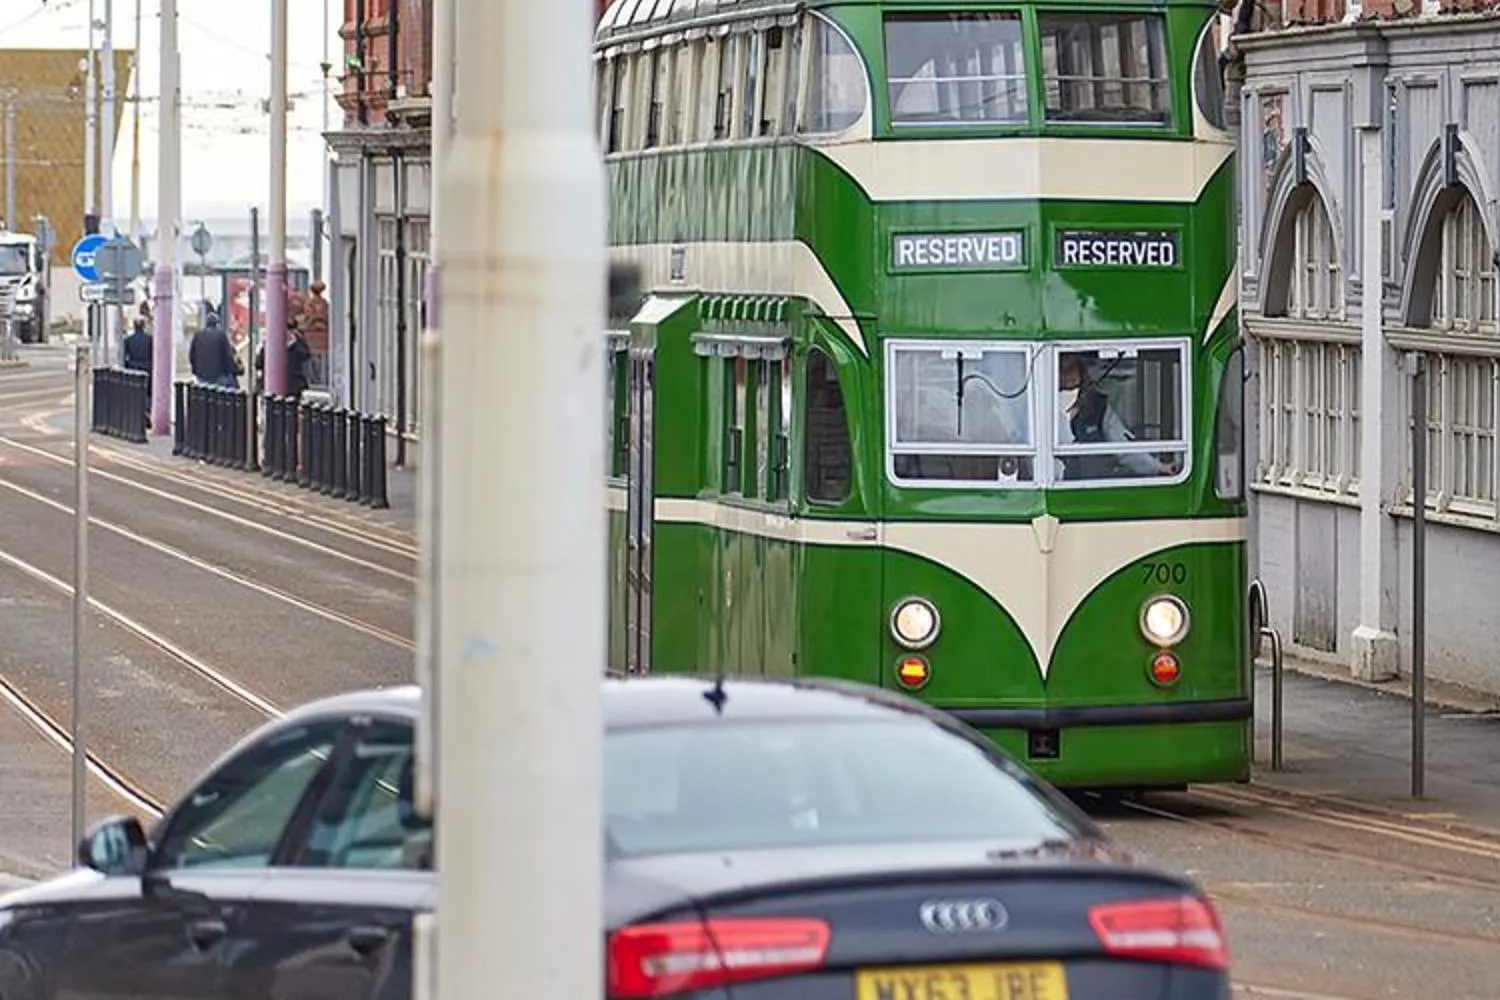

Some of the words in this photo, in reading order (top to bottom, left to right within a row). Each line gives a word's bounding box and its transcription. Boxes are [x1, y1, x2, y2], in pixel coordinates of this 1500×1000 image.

[899, 236, 1017, 265] RESERVED
[1063, 240, 1174, 266] RESERVED
[1142, 562, 1187, 585] 700
